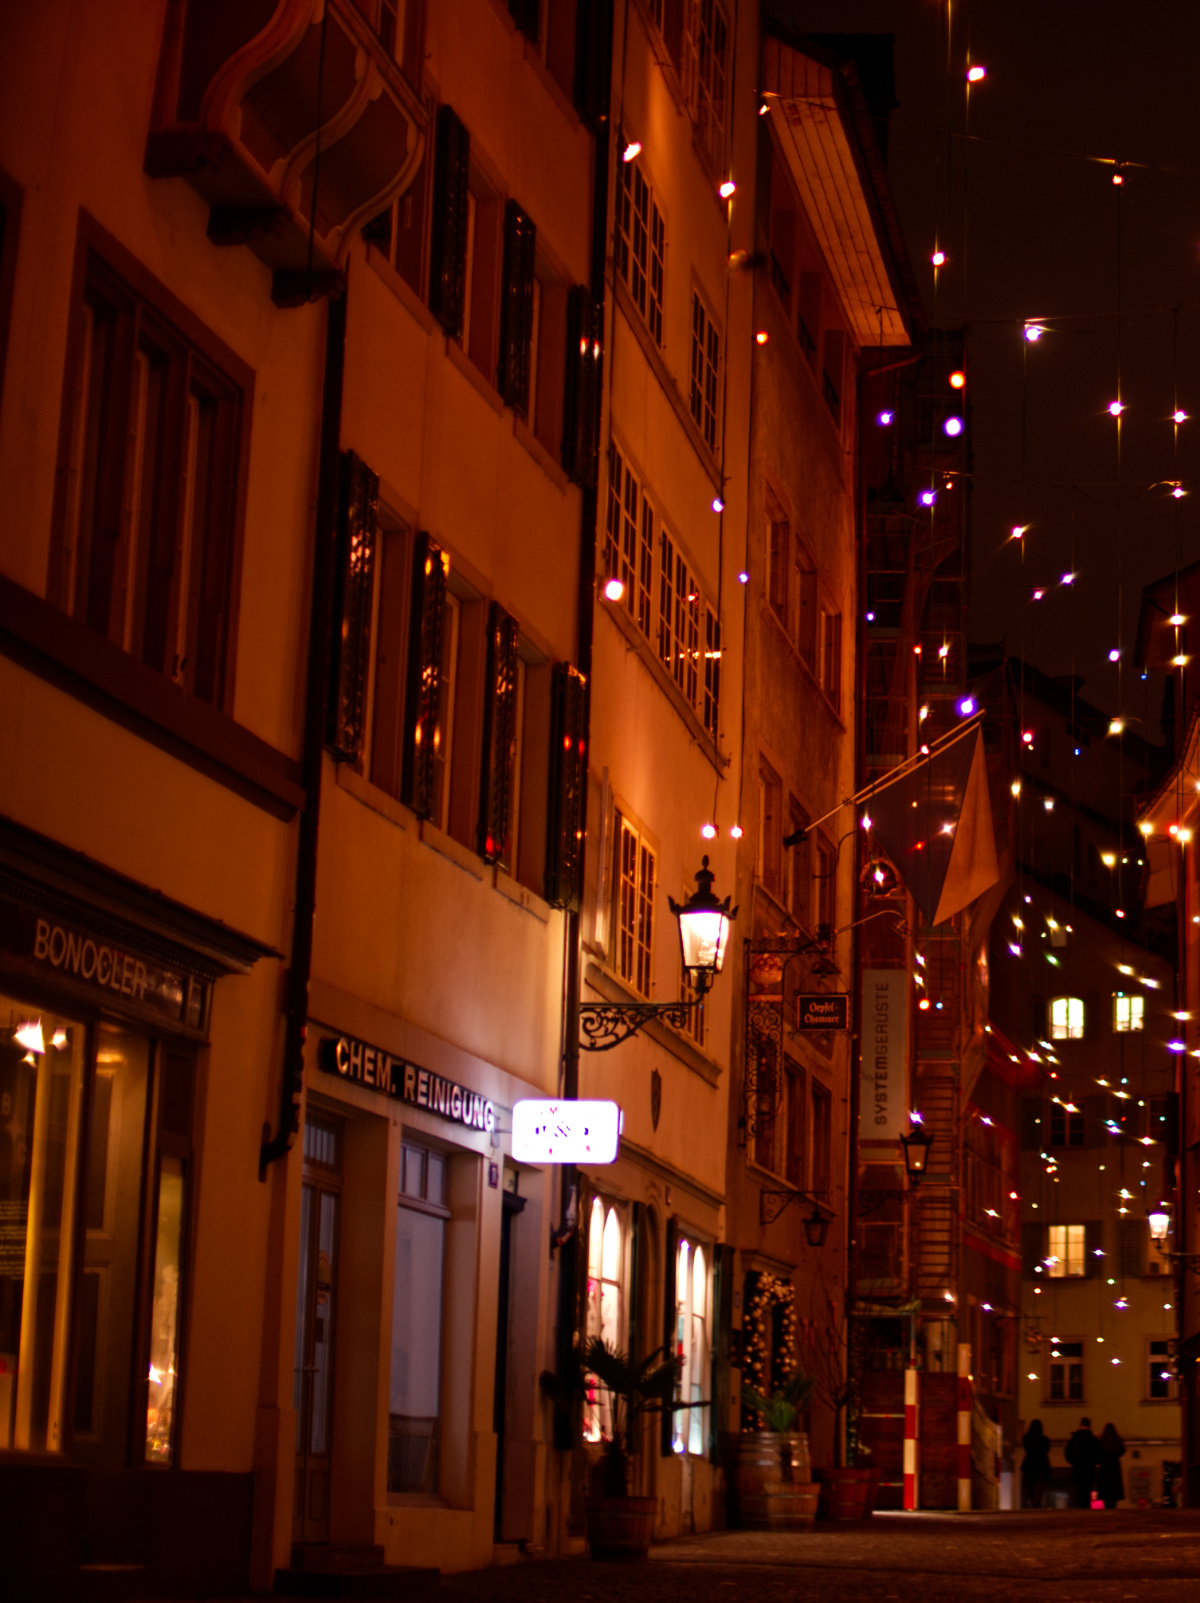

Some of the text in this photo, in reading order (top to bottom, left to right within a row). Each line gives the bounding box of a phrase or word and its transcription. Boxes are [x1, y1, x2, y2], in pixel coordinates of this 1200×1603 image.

[33, 918, 148, 1000] BONOCLER
[336, 1037, 396, 1094] CHEM.
[404, 1065, 495, 1132] REINIGUNG
[873, 983, 889, 1126] SYSTEMGERÜSTE
